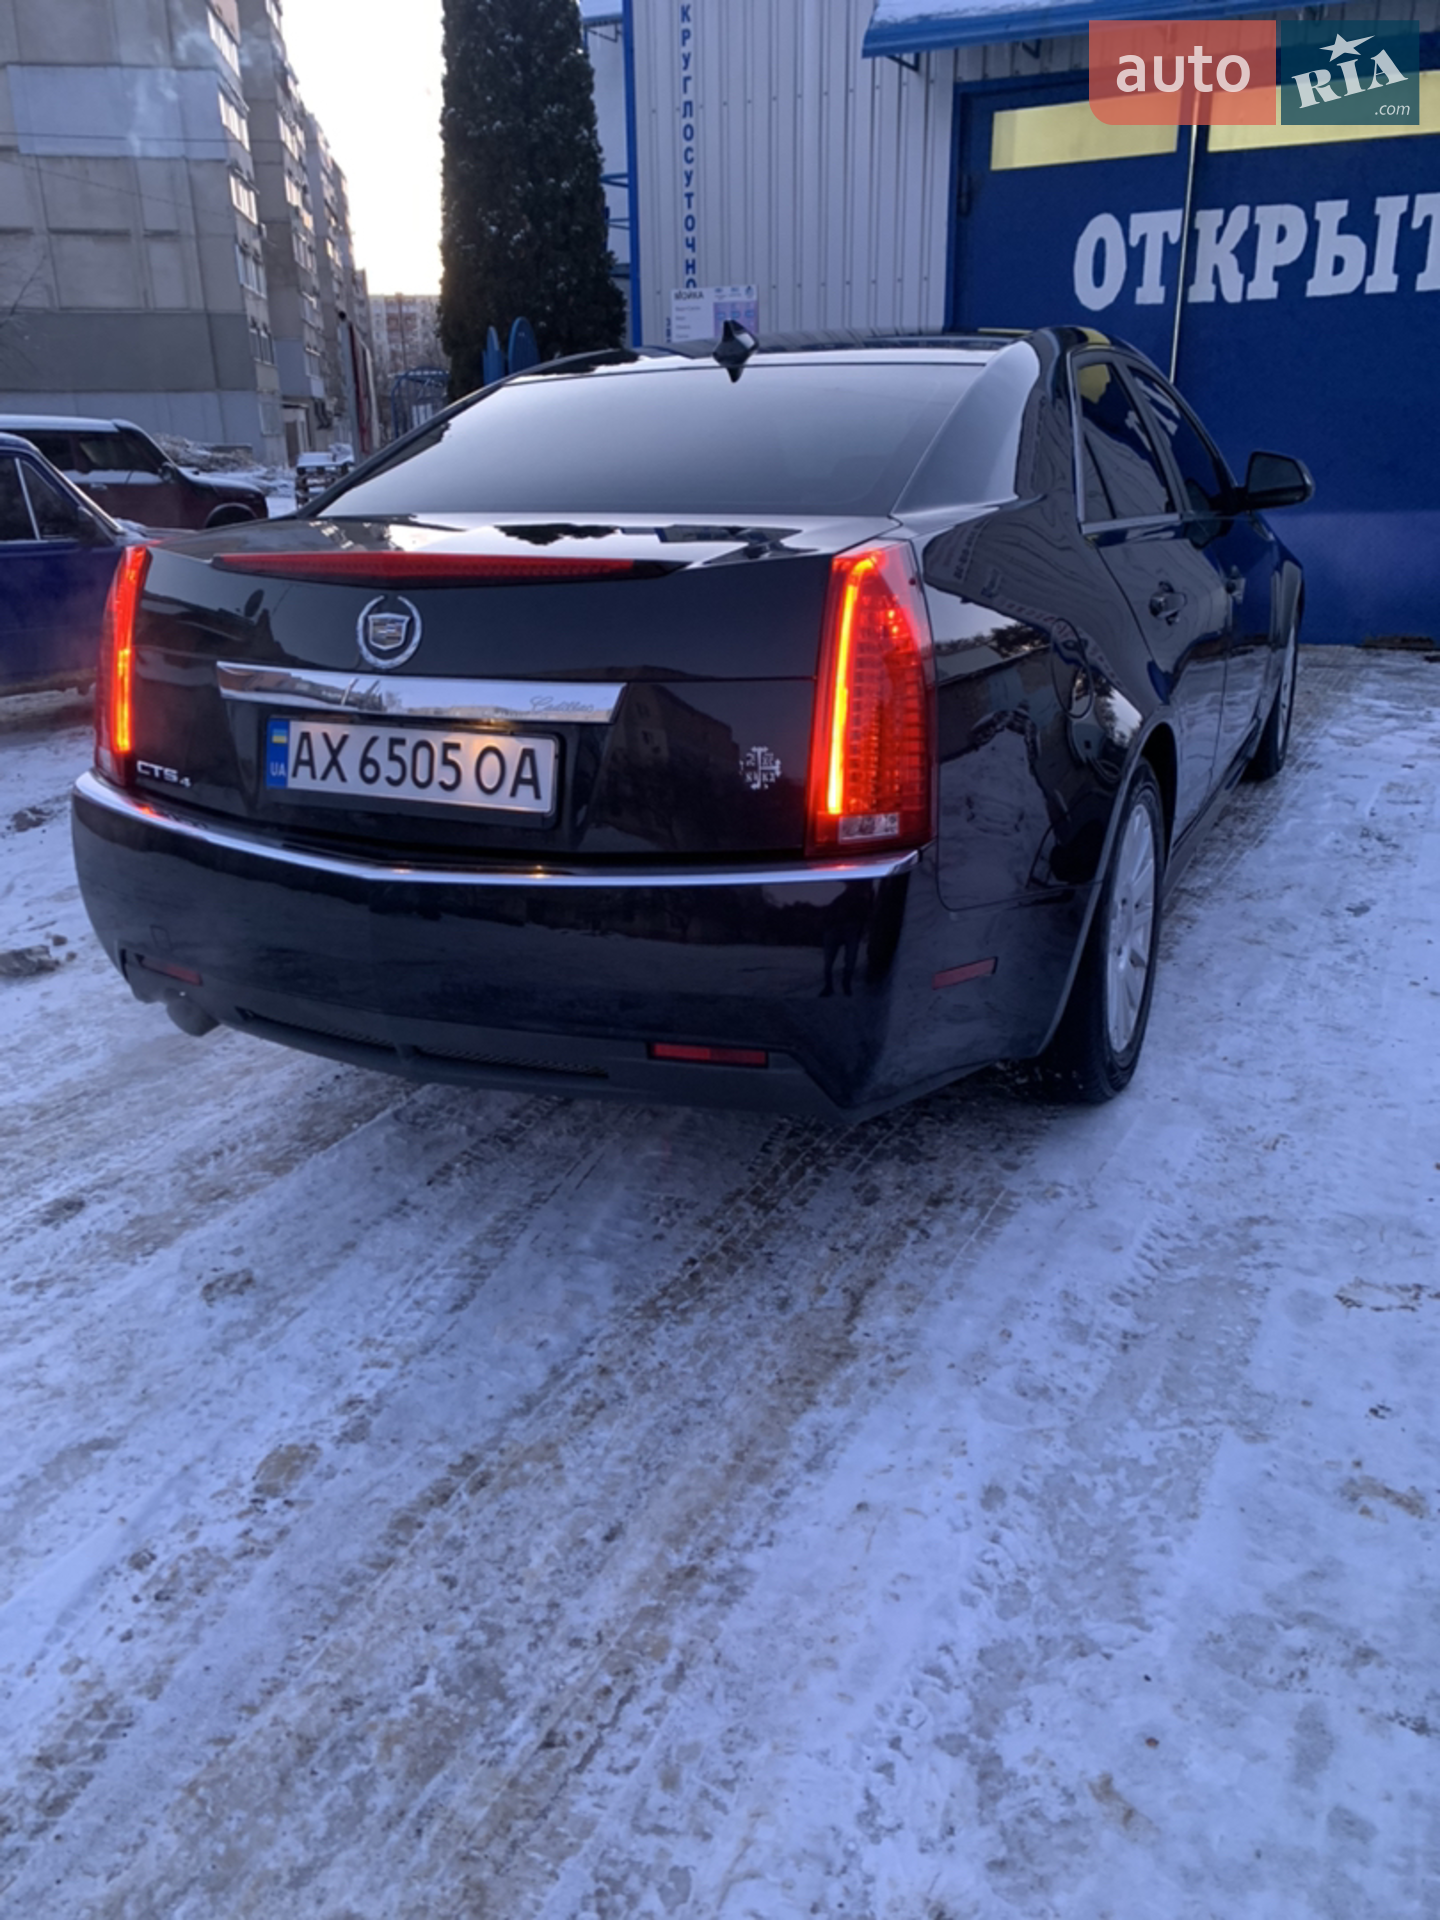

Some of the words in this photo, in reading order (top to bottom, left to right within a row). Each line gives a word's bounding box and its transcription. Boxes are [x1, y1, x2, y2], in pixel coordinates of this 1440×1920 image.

[269, 762, 286, 776] UA
[291, 731, 349, 782] AX
[358, 735, 462, 792] 6505
[475, 745, 542, 800] OA
